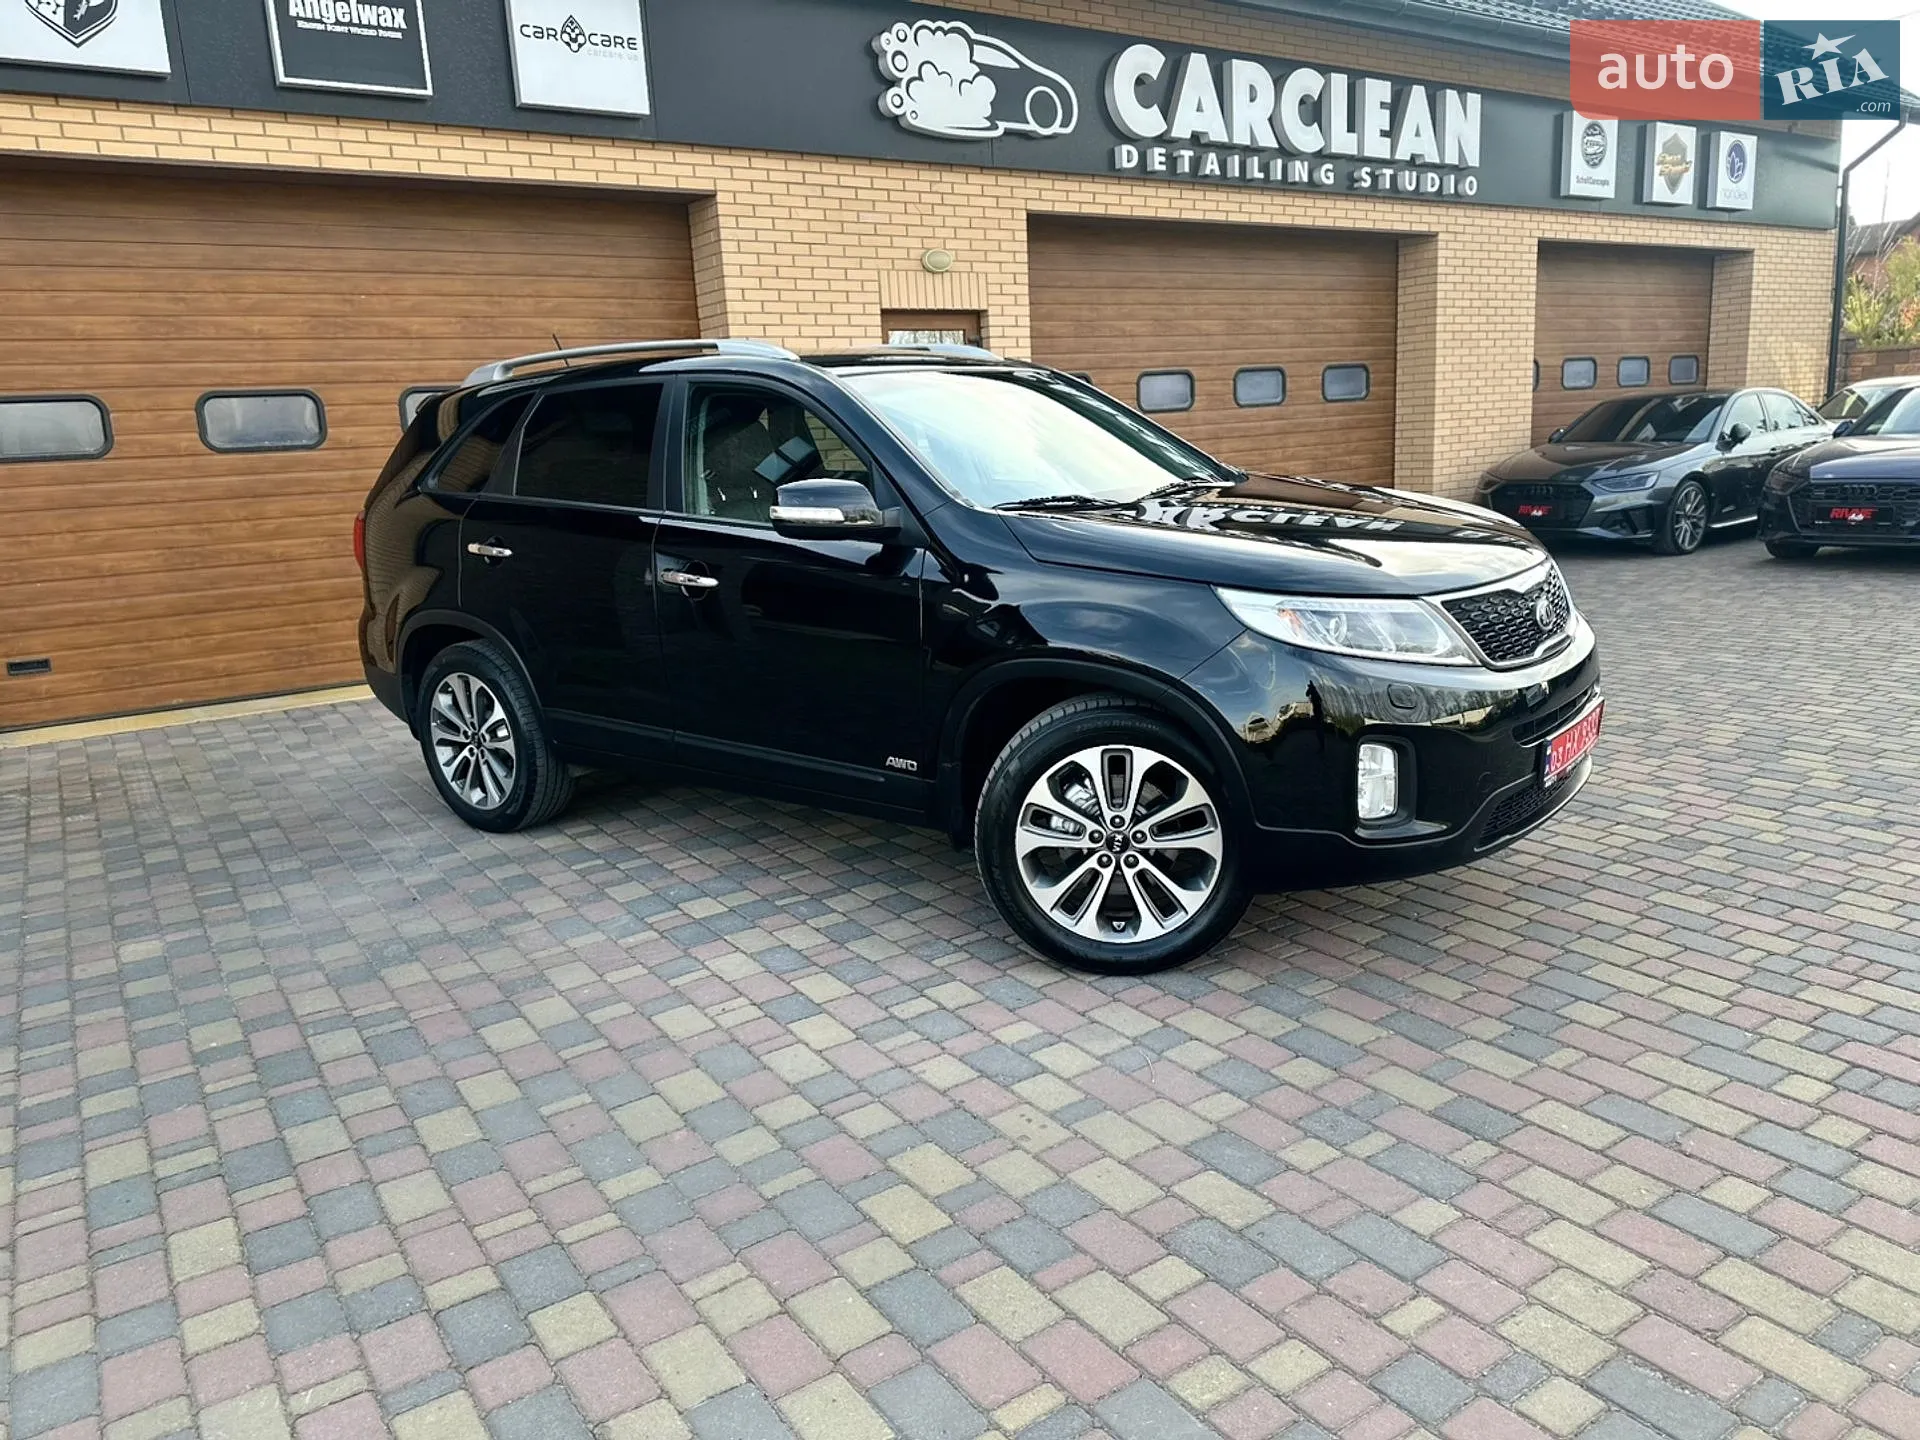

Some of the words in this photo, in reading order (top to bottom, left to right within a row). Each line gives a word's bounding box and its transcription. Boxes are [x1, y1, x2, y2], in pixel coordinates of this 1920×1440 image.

[288, 0, 408, 29] Angelwax
[1104, 43, 1482, 168] CARCLEAN
[1114, 143, 1336, 186] DETAILING
[1353, 165, 1479, 197] STUDIO
[885, 756, 918, 771] AWD
